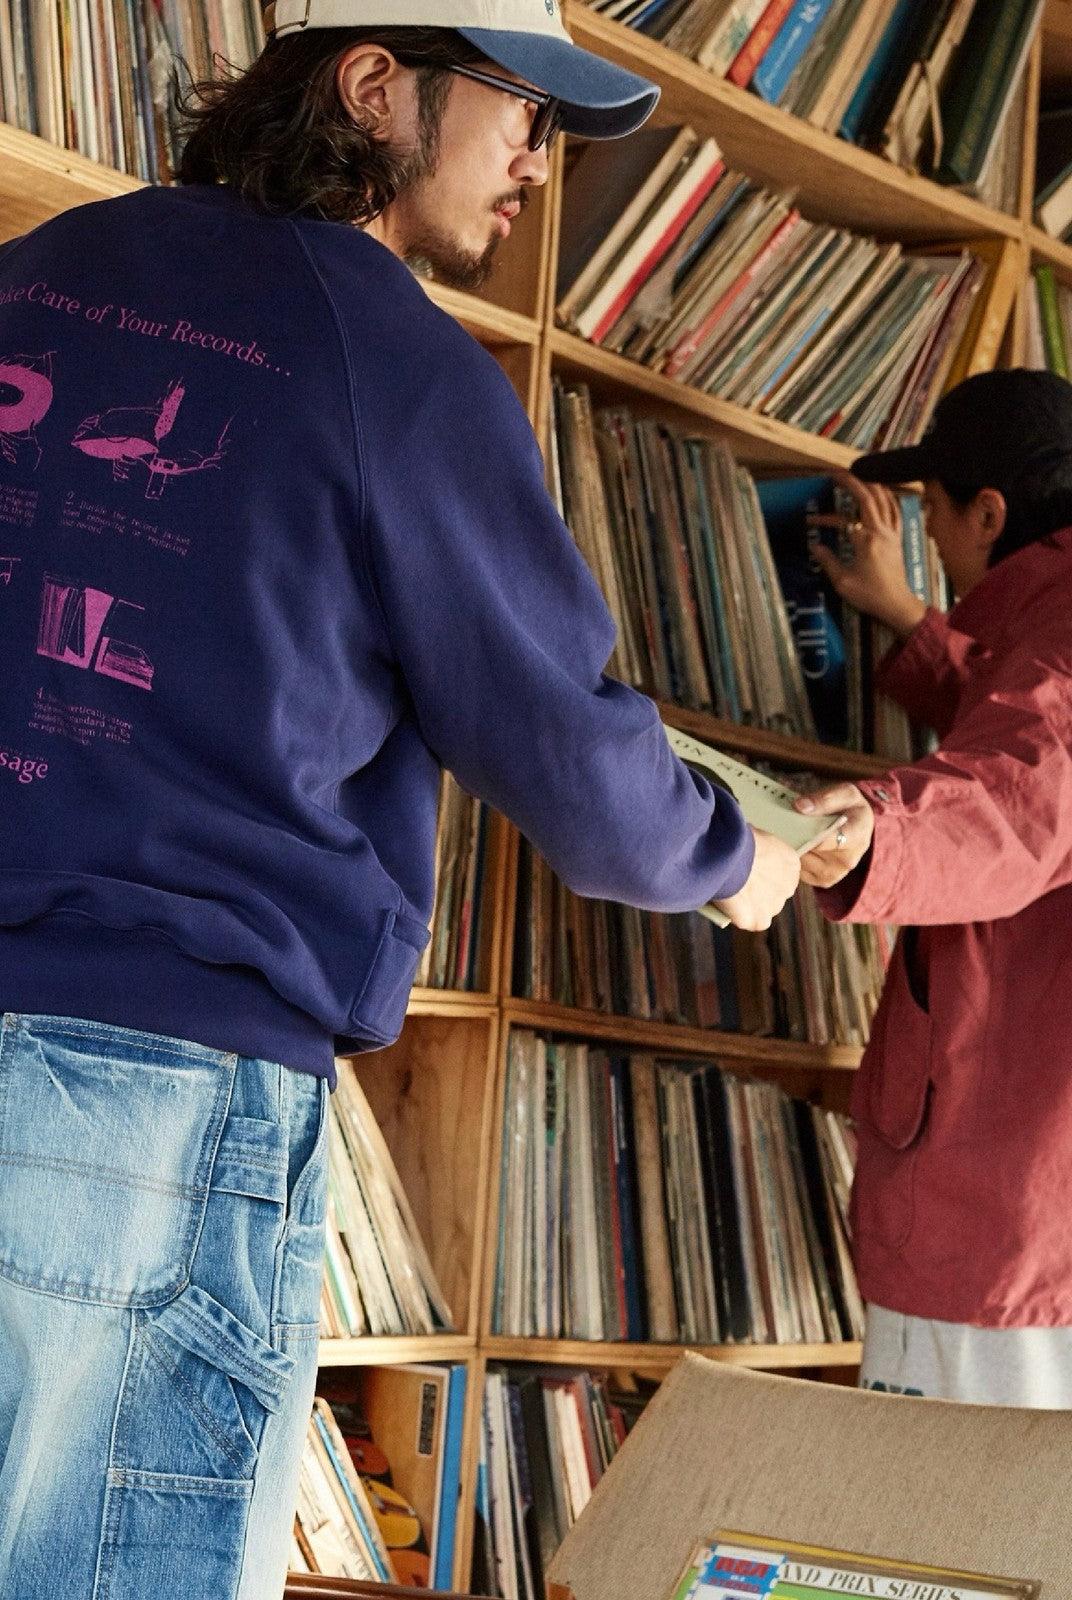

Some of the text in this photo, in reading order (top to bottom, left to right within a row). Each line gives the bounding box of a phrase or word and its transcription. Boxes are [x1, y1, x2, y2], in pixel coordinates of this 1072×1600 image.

[28, 282, 80, 314] Care
[86, 304, 114, 323] of
[117, 308, 168, 338] Your
[170, 319, 291, 377] Records...
[0, 752, 48, 784] sage
[715, 1557, 770, 1578] RCA
[828, 1572, 880, 1594] PRIX
